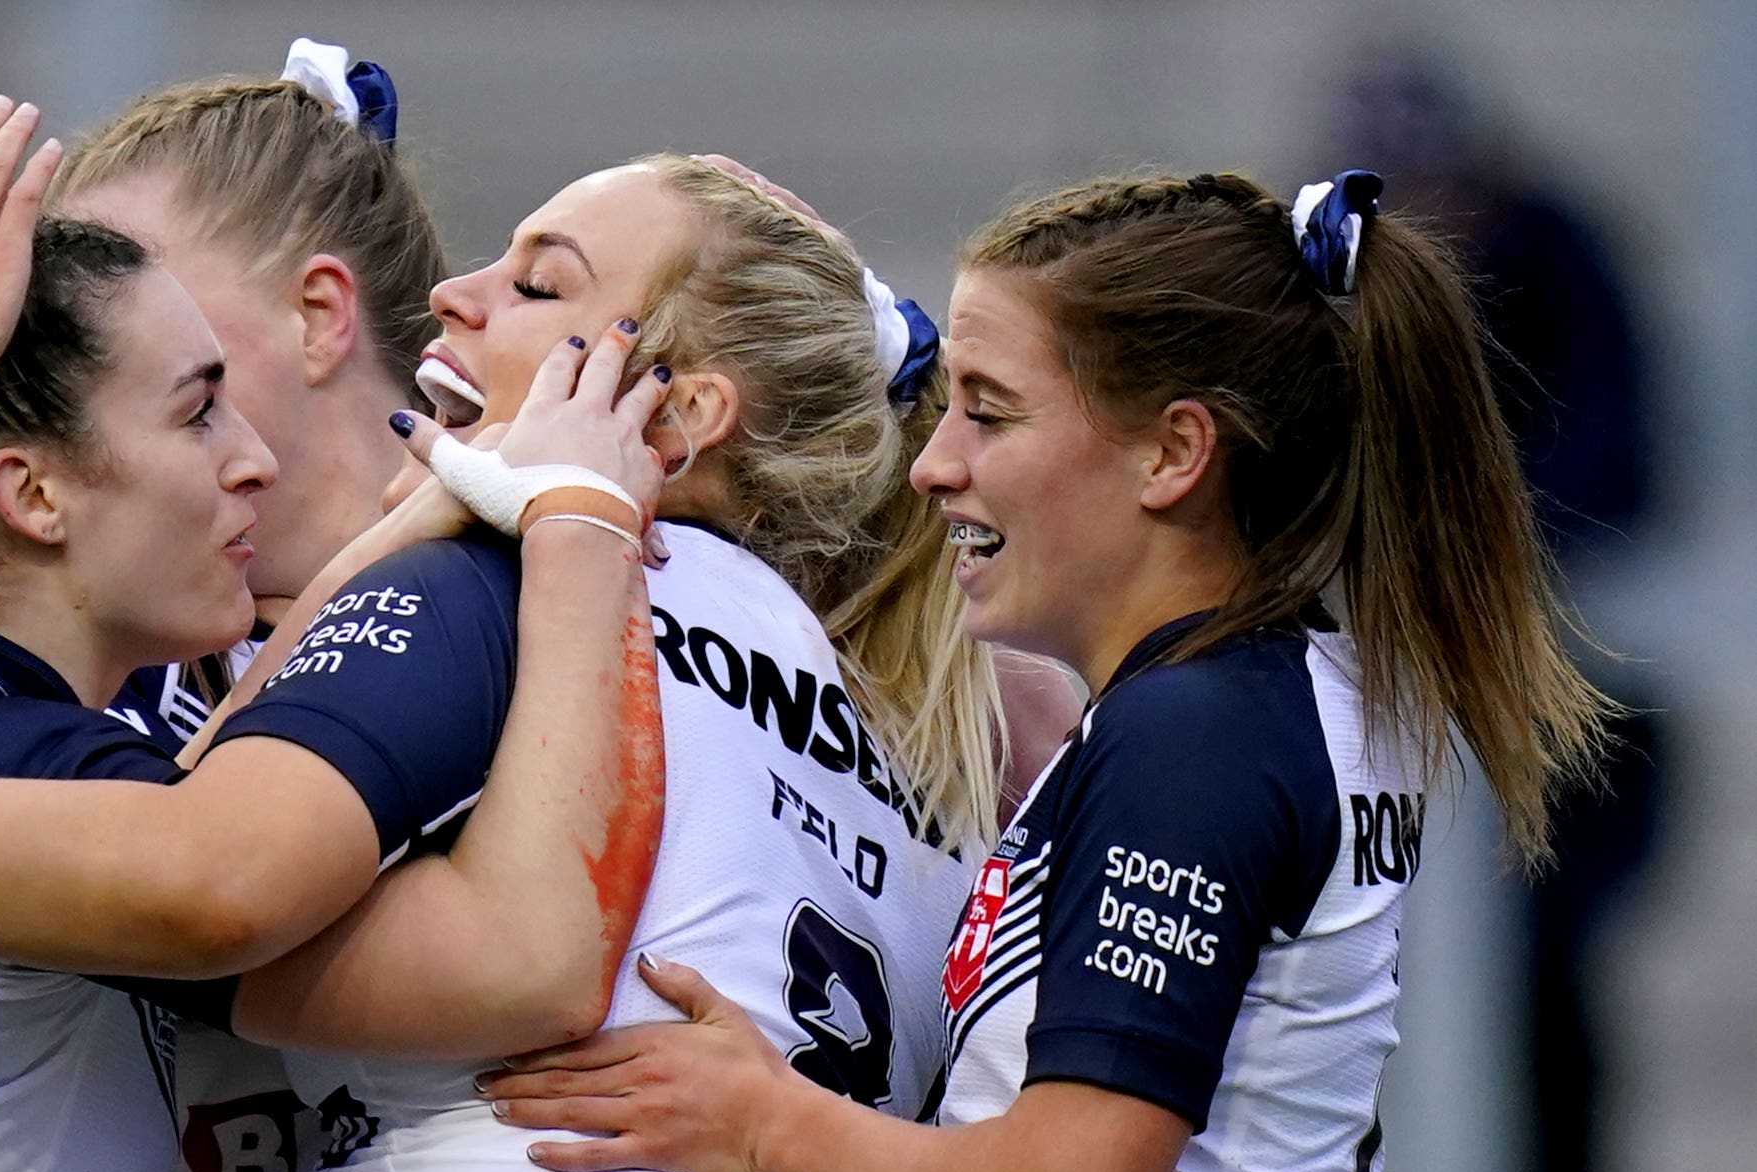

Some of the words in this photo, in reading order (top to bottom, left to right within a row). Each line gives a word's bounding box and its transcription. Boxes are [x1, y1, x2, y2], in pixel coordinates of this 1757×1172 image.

[292, 616, 413, 654] reaks
[1104, 845, 1226, 915] sports
[1098, 885, 1219, 966] breaks
[1084, 939, 1167, 994] .com
